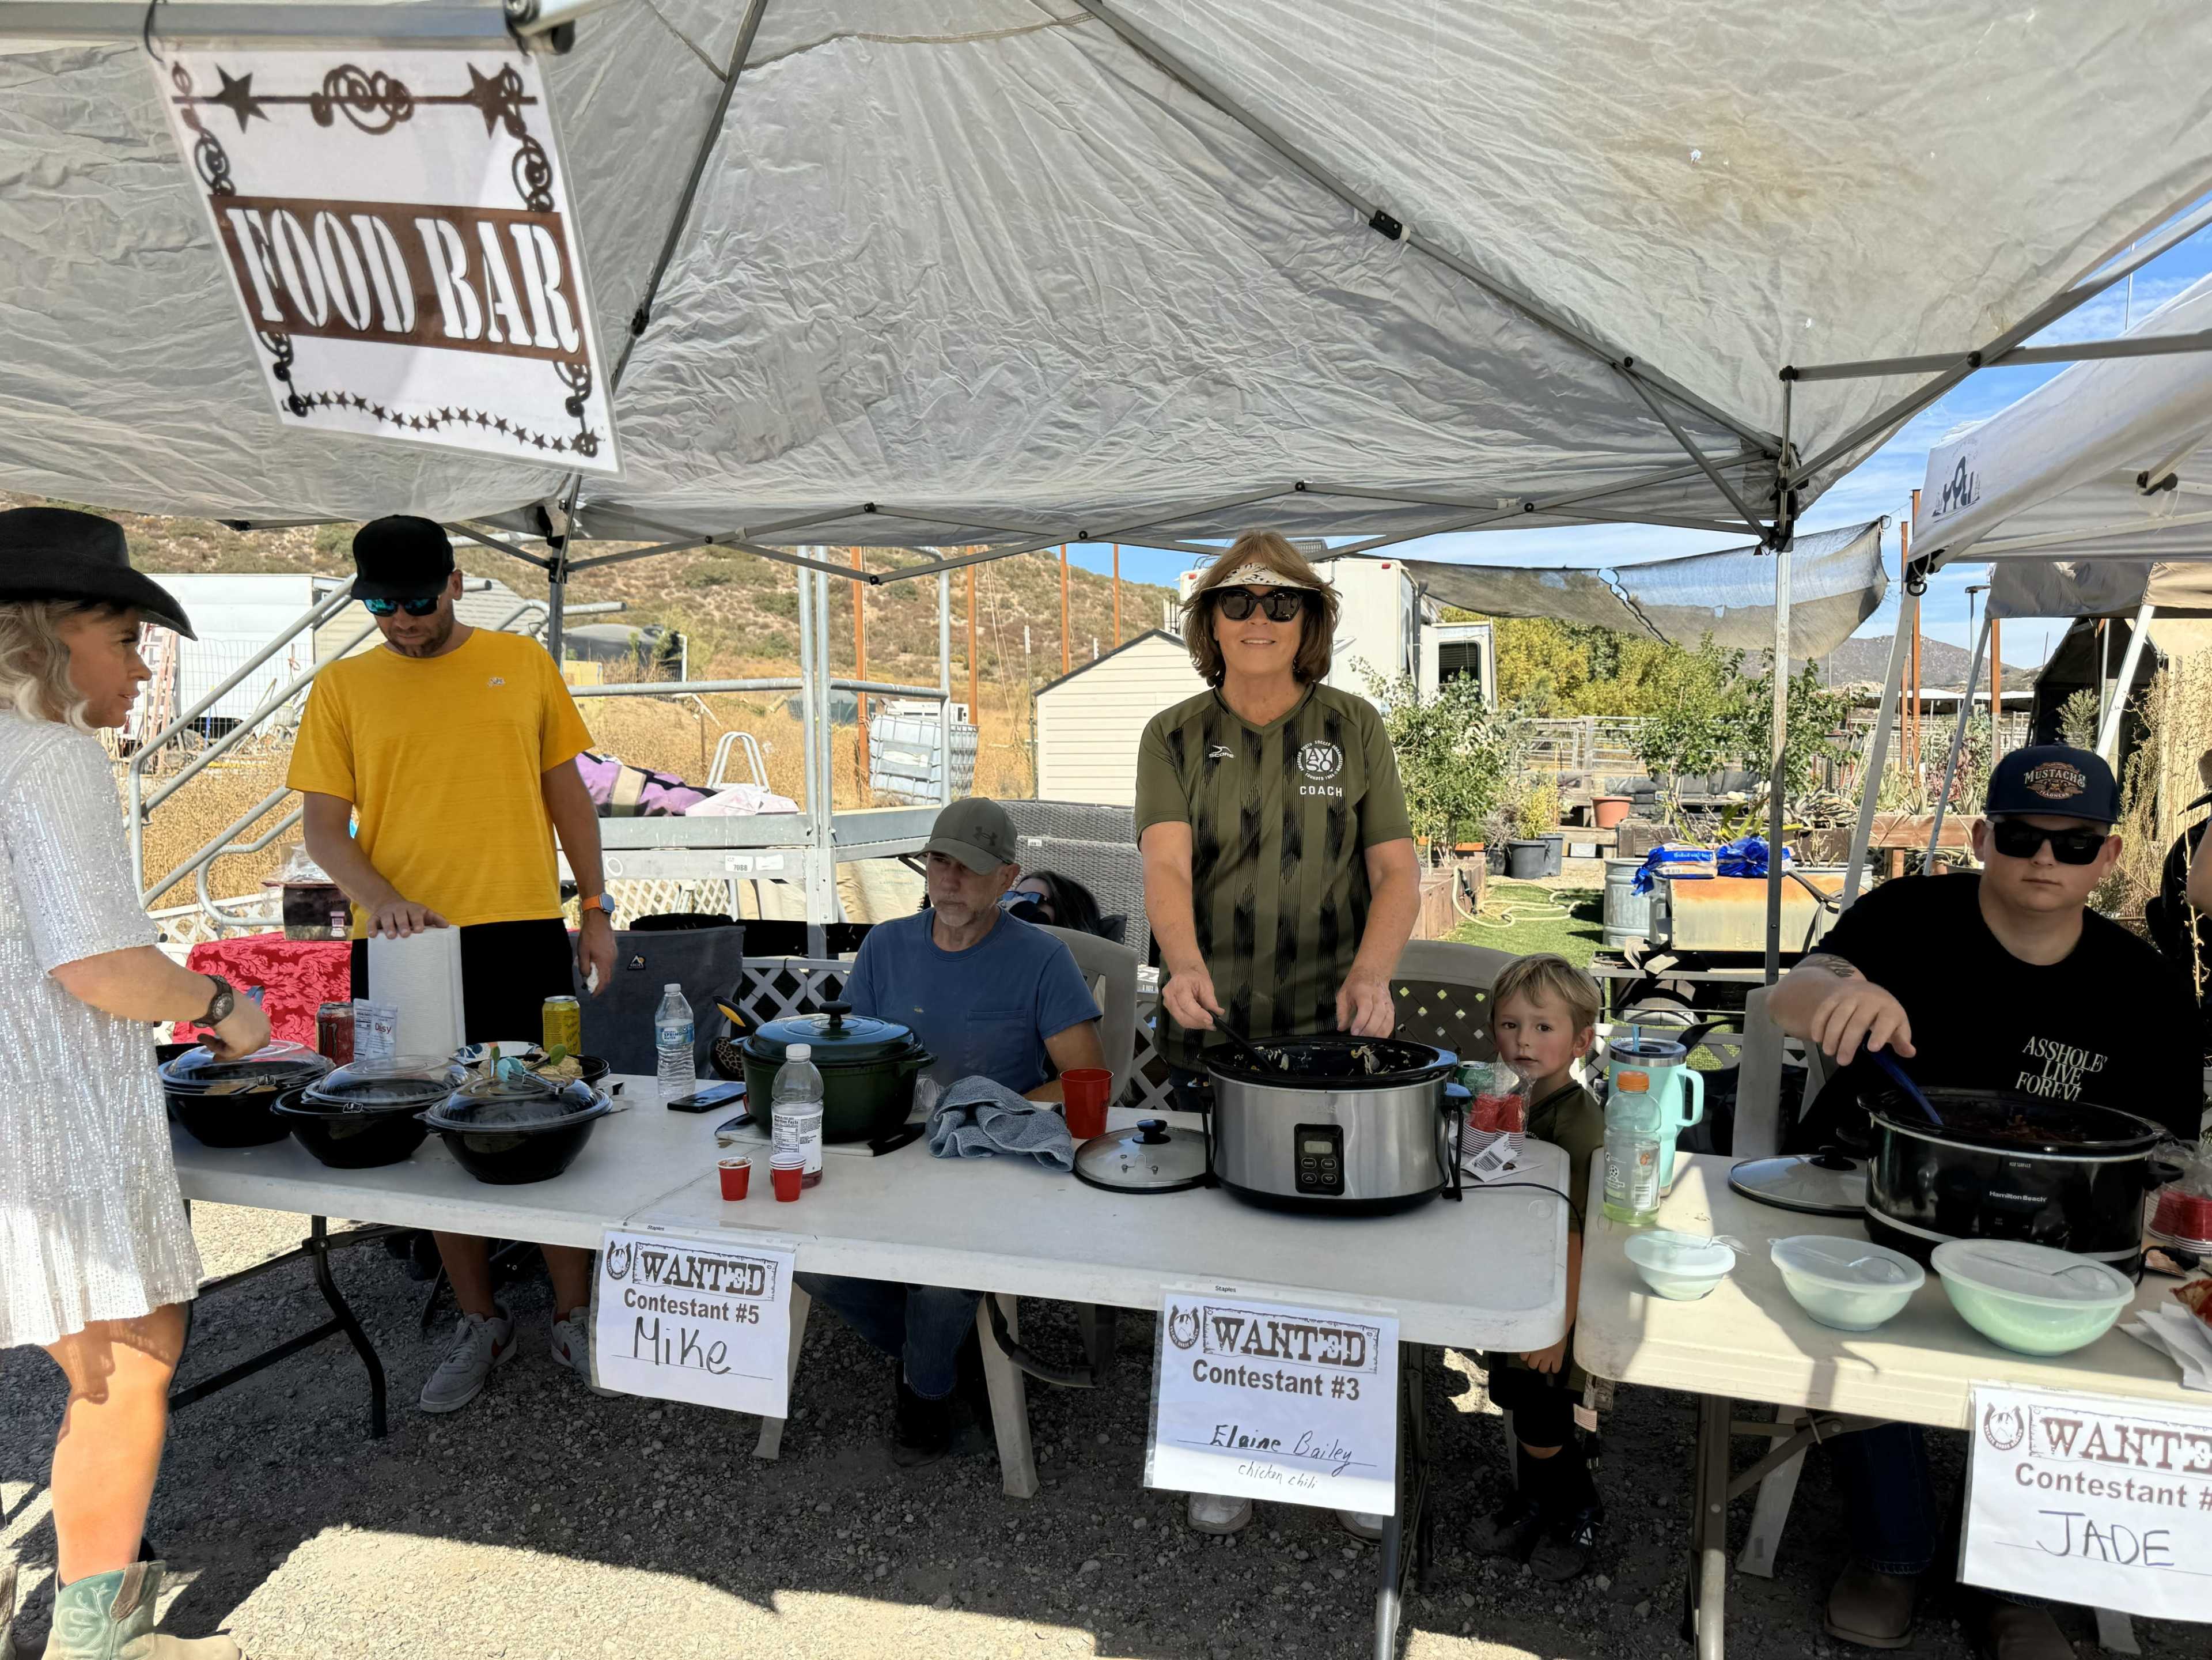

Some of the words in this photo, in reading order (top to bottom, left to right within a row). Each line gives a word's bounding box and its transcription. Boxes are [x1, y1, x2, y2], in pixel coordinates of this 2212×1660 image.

[225, 207, 416, 334] FOOD
[415, 218, 580, 354] BAR
[1300, 785, 1342, 797] COACH
[2024, 769, 2086, 788] MUSTACHE
[2041, 1060, 2084, 1087] LIVE
[1989, 1190, 2022, 1200] Hamilton
[641, 1251, 766, 1296] WANTED
[624, 1288, 729, 1321] Contestant
[736, 1303, 759, 1324] #5
[634, 1316, 732, 1374] Mike
[1211, 1316, 1366, 1367] WANTED
[1193, 1359, 1323, 1396] Contestant
[1331, 1376, 1359, 1401] #3
[1210, 1424, 1281, 1453] Elaine
[1294, 1431, 1352, 1476] Bailey
[1288, 1473, 1317, 1489] chili
[2016, 1462, 2187, 1507] Contestant
[2036, 1510, 2175, 1566] JADE
